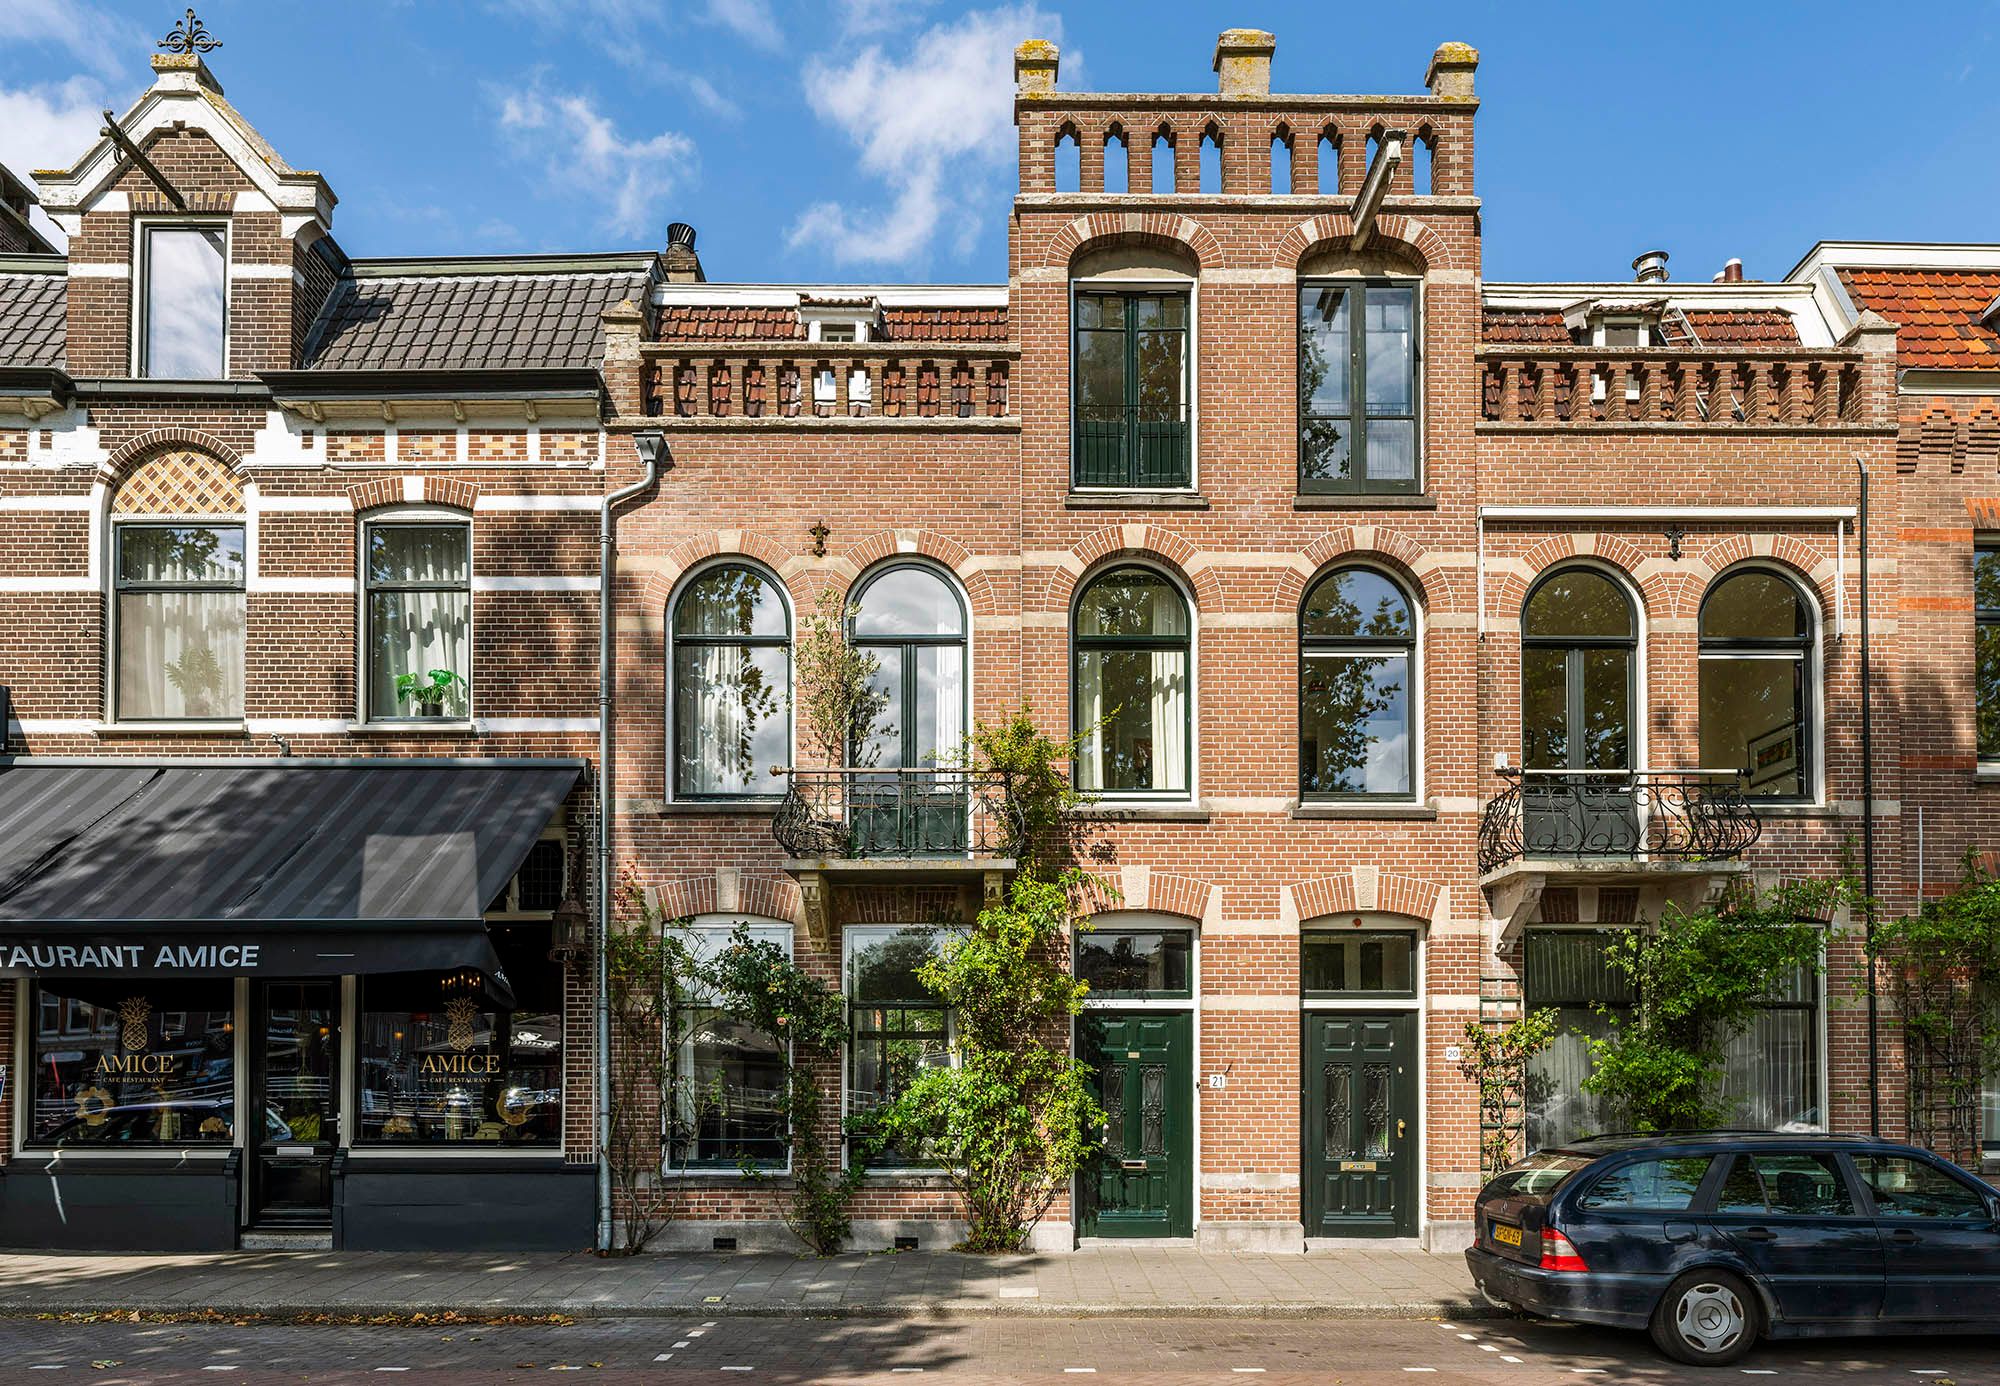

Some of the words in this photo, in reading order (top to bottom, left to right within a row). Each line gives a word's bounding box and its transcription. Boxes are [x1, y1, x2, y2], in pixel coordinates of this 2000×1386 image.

[154, 945, 259, 967] AMICE
[94, 1055, 174, 1073] AMICE
[420, 1055, 500, 1073] AMICE
[1213, 1076, 1222, 1086] 21
